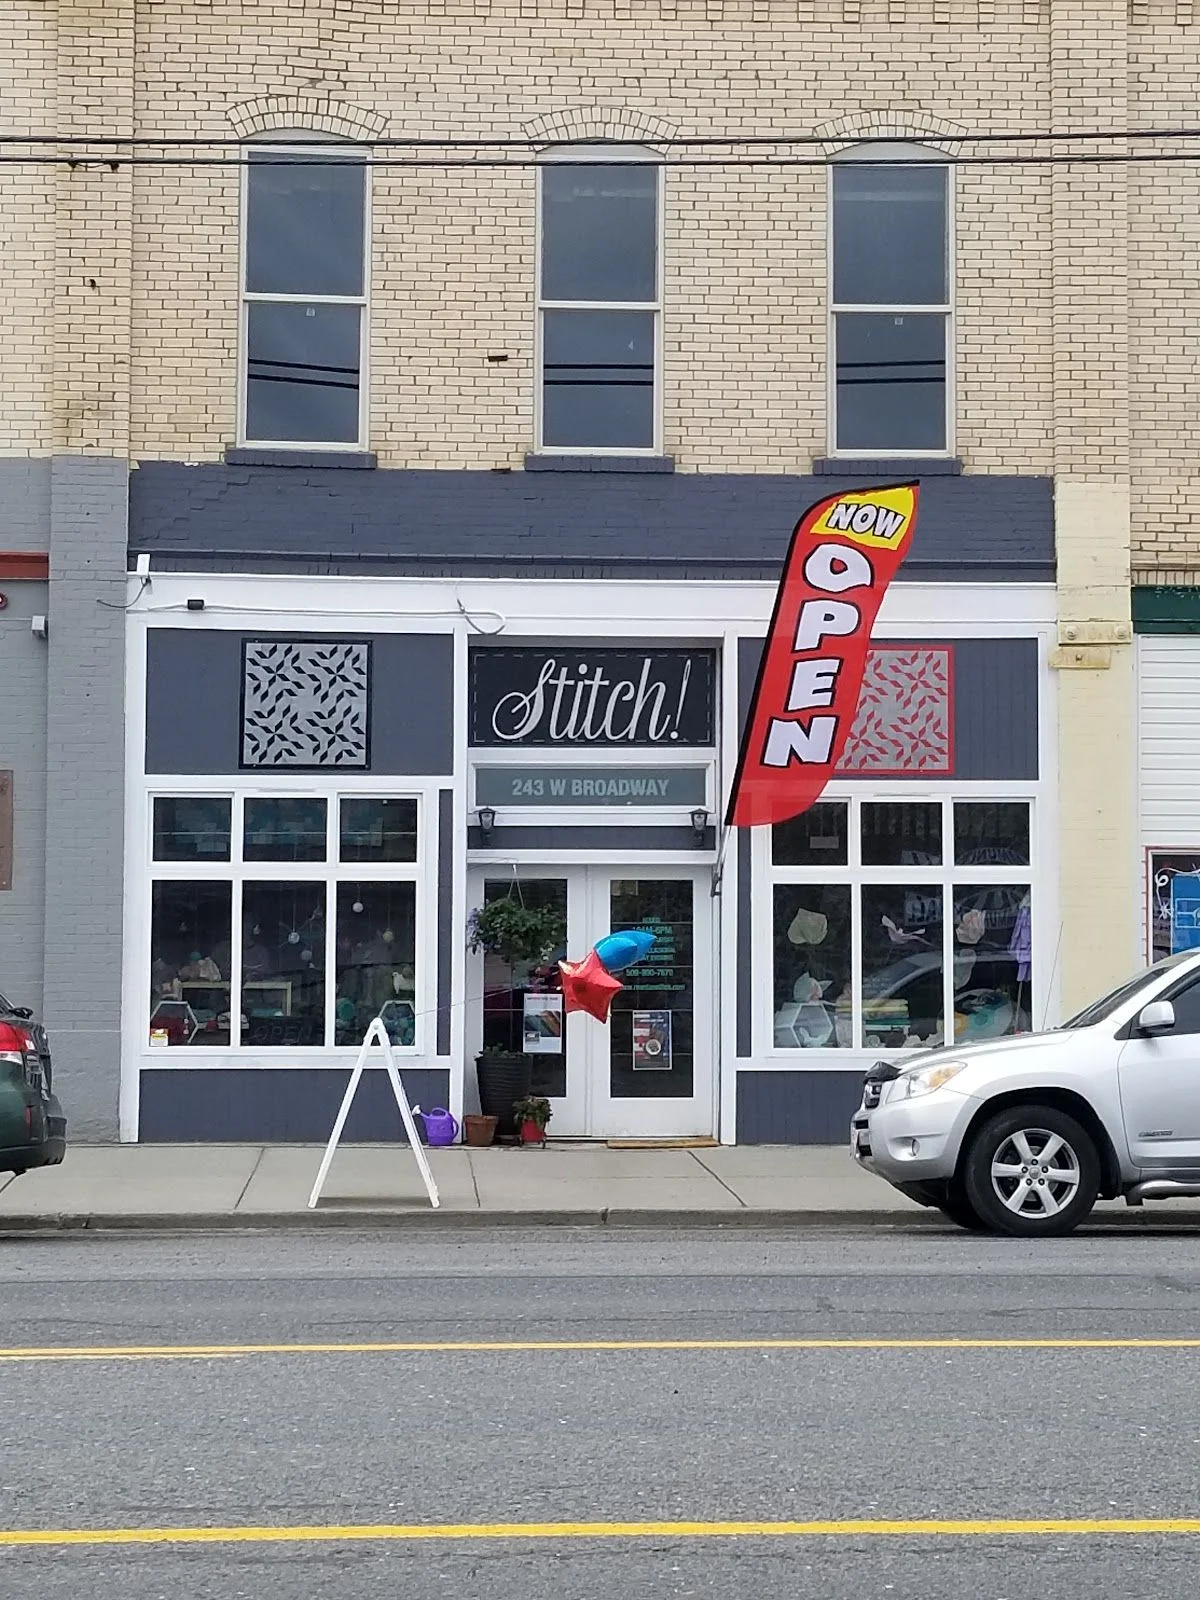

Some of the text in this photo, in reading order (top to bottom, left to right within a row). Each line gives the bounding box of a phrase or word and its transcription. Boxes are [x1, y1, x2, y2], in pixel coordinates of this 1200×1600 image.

[827, 504, 905, 539] NOW
[760, 543, 874, 767] OPEN
[492, 658, 692, 741] Stitch!
[511, 779, 670, 797] 243 W BROADWAY
